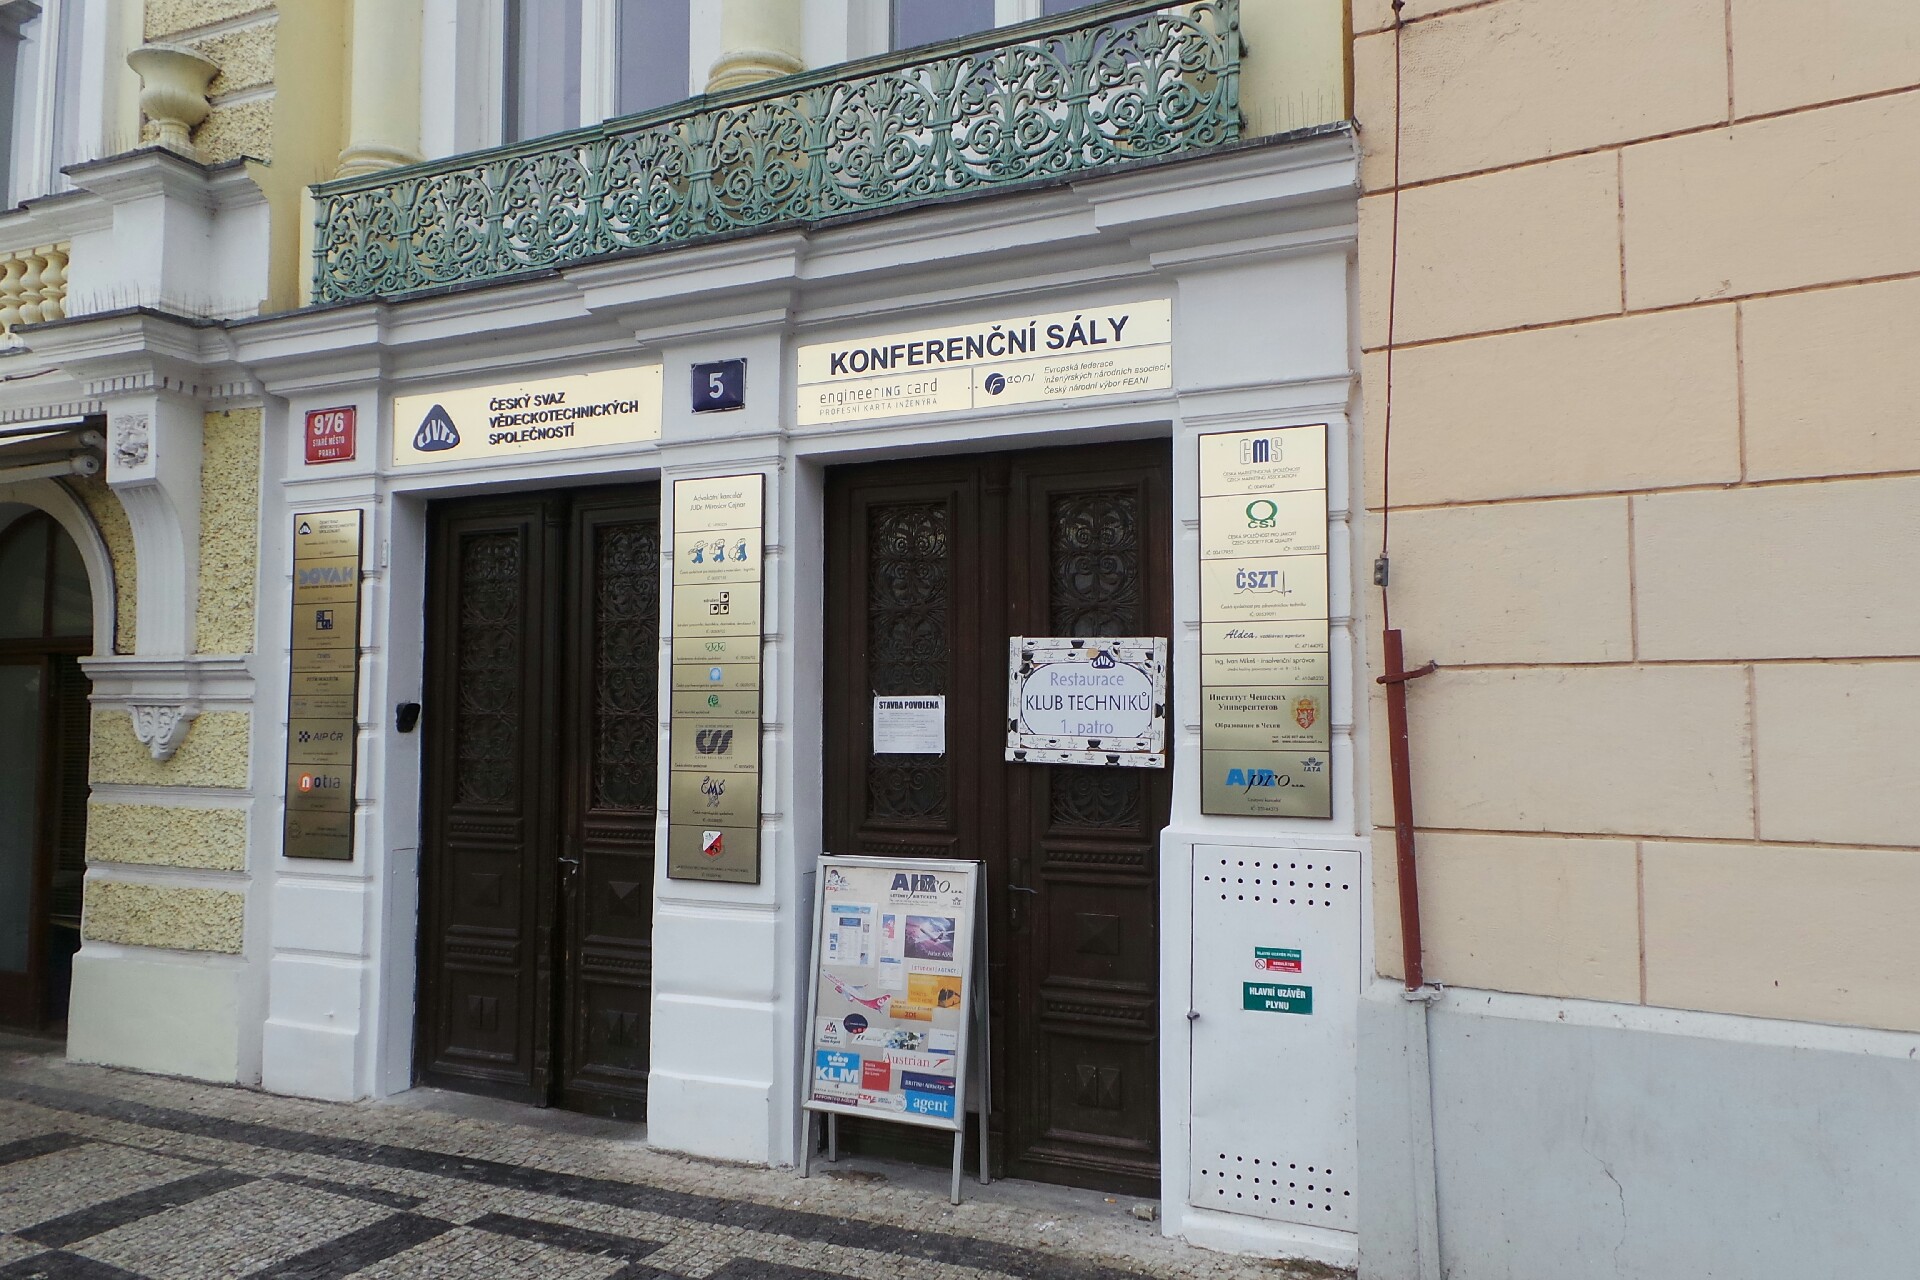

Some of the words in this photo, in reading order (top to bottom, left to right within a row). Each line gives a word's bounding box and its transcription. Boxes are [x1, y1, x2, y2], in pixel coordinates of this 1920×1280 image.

[830, 320, 1036, 375] KONFERENČNÍ
[1046, 315, 1128, 350] SÁLY
[1044, 363, 1078, 374] Evropská
[1081, 360, 1114, 370] federace
[1094, 368, 1132, 378] národních
[709, 373, 723, 398] 5
[908, 378, 937, 394] card
[1044, 385, 1066, 395] Český
[1069, 382, 1097, 392] národní
[1100, 380, 1120, 390] výbor
[1123, 376, 1148, 386] FEANI
[490, 394, 530, 412] ČESKÝ
[534, 392, 565, 406] SVAZ
[820, 406, 859, 416] PROFESNÍ
[864, 402, 891, 411] KARTA
[489, 400, 638, 428] VĚDECKOTECHNICKÝCH
[314, 412, 344, 435] 976
[313, 436, 327, 447] STARÉ
[329, 435, 344, 445] MĚSTO
[489, 423, 574, 445] SPOLEČNOSTÍ
[319, 448, 335, 457] PRAHA
[1248, 519, 1276, 529] ČSJ
[1236, 568, 1278, 588] ČSZT
[1051, 672, 1124, 686] Restaurace
[879, 701, 903, 709] STAVBA
[905, 701, 940, 709] POVOLENA
[1026, 695, 1063, 710] KLUB
[1068, 692, 1150, 710] TECHNIKŮ
[1209, 694, 1247, 702] Институт
[1218, 703, 1278, 712] Университетов
[313, 732, 328, 741] AIP
[330, 731, 344, 741] ČR
[1061, 720, 1072, 733] 1.
[1078, 721, 1113, 736] patro
[1225, 768, 1275, 787] AIR
[1243, 775, 1291, 794] pro
[891, 873, 936, 892] AIR
[1249, 986, 1275, 996] HLAVNÍ
[1278, 988, 1306, 999] UZÁVĚR
[1266, 1000, 1289, 1010] PLYNU
[884, 1052, 930, 1067] Austrian
[815, 1066, 858, 1083] KLM
[913, 1097, 948, 1113] agent
